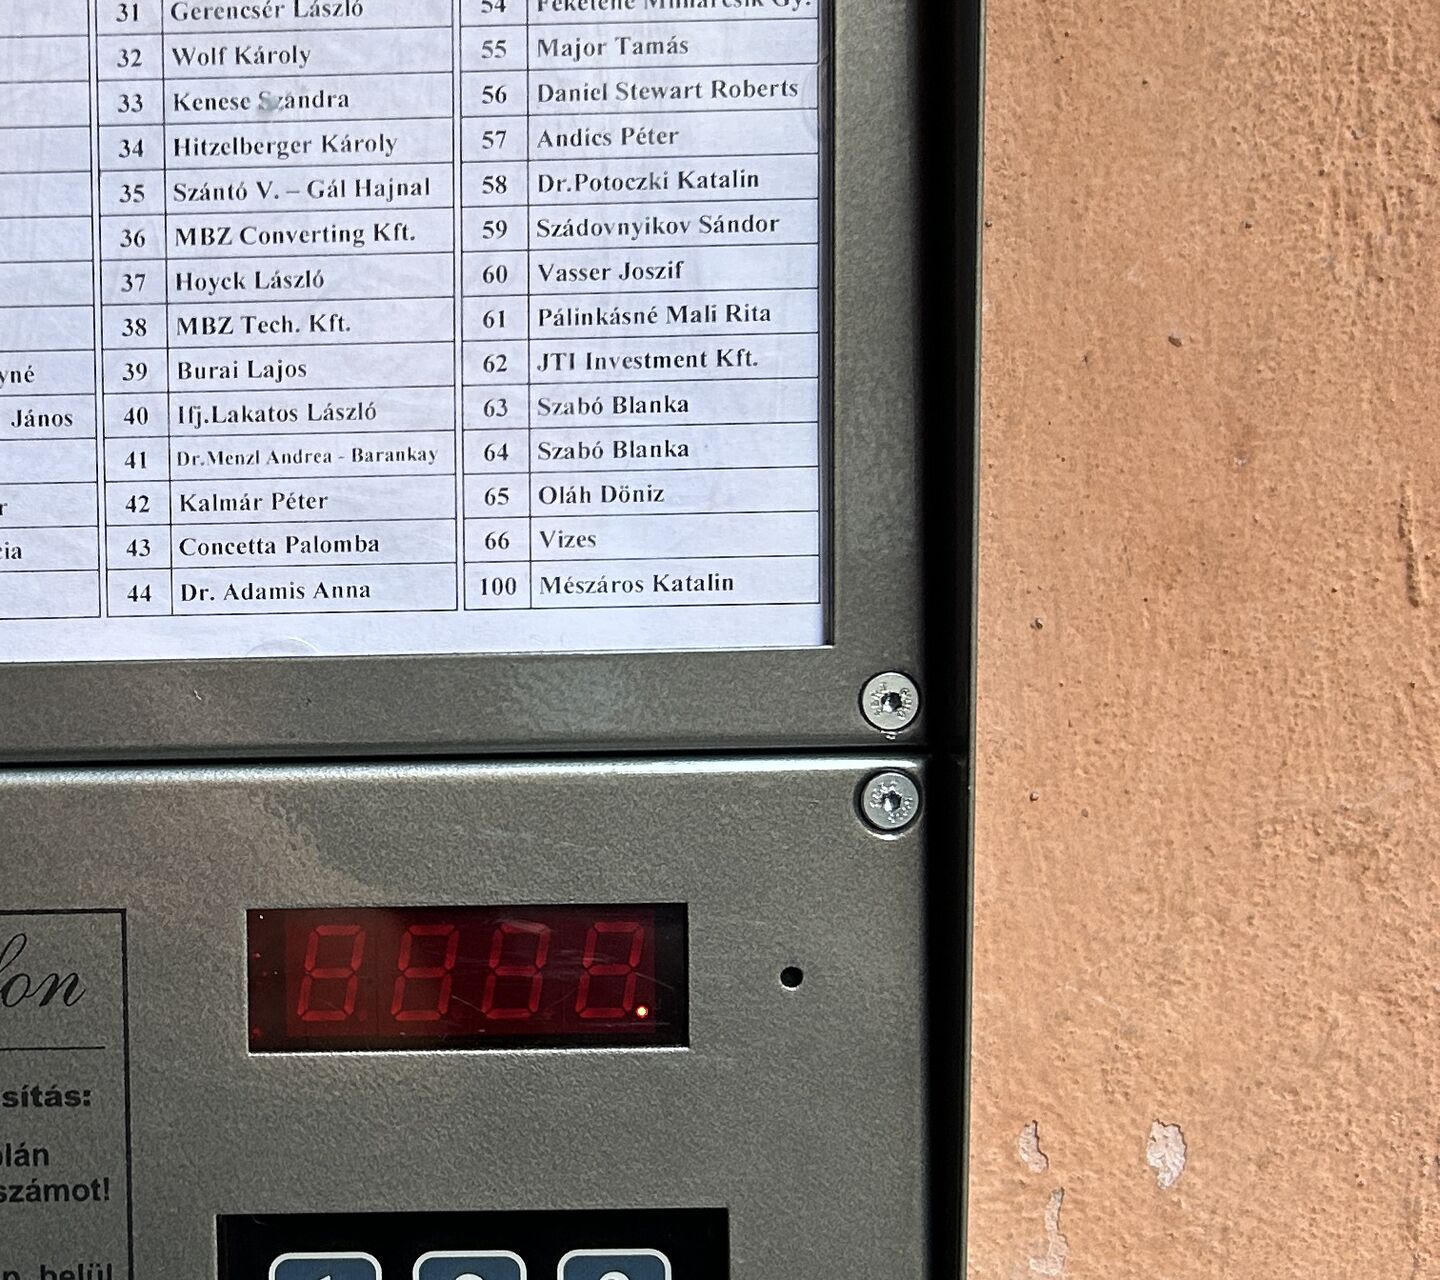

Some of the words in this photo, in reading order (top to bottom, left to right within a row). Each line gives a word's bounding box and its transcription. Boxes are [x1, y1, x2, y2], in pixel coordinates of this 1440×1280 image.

[115, 2, 138, 23] 31
[116, 48, 143, 68] 32
[171, 46, 228, 67] Wolf
[235, 44, 311, 69] Károly
[481, 85, 507, 105] 56
[538, 82, 608, 103] Daniel
[615, 81, 703, 101] Stewart
[711, 79, 798, 99] Roberts
[118, 138, 144, 159] 34
[322, 133, 394, 158] Károly
[481, 129, 507, 150] 57
[621, 126, 680, 146] Péter
[481, 175, 507, 195] 58
[677, 168, 759, 190] Katalin
[119, 228, 146, 248] 36
[175, 226, 233, 247] MBZ
[239, 224, 365, 248] Converting
[373, 222, 415, 242] Kft.
[482, 219, 508, 240] 59
[698, 213, 780, 234] Sándor
[482, 264, 508, 284] 60
[537, 263, 612, 282] Vasser
[618, 260, 685, 281] Joszif
[121, 317, 147, 337] 38
[176, 315, 234, 336] MBZ
[240, 314, 300, 335] Tech.
[309, 313, 351, 333] Kft.
[482, 309, 505, 329] 61
[538, 305, 658, 327] Pálinkásné
[666, 304, 717, 325] Mali
[725, 303, 771, 323] Rita
[122, 362, 148, 382] 39
[178, 359, 238, 380] Burai
[247, 359, 307, 384] Lajos
[10, 408, 73, 428] János
[123, 406, 149, 426] 40
[307, 401, 377, 422] László
[125, 494, 150, 513] 42
[180, 492, 263, 513] Kalmár
[271, 491, 329, 511] Péter
[484, 531, 510, 551] 66
[539, 529, 597, 549] Vizes
[481, 577, 517, 596] 100
[540, 574, 644, 595] Mészáros
[652, 572, 734, 593] Katalin
